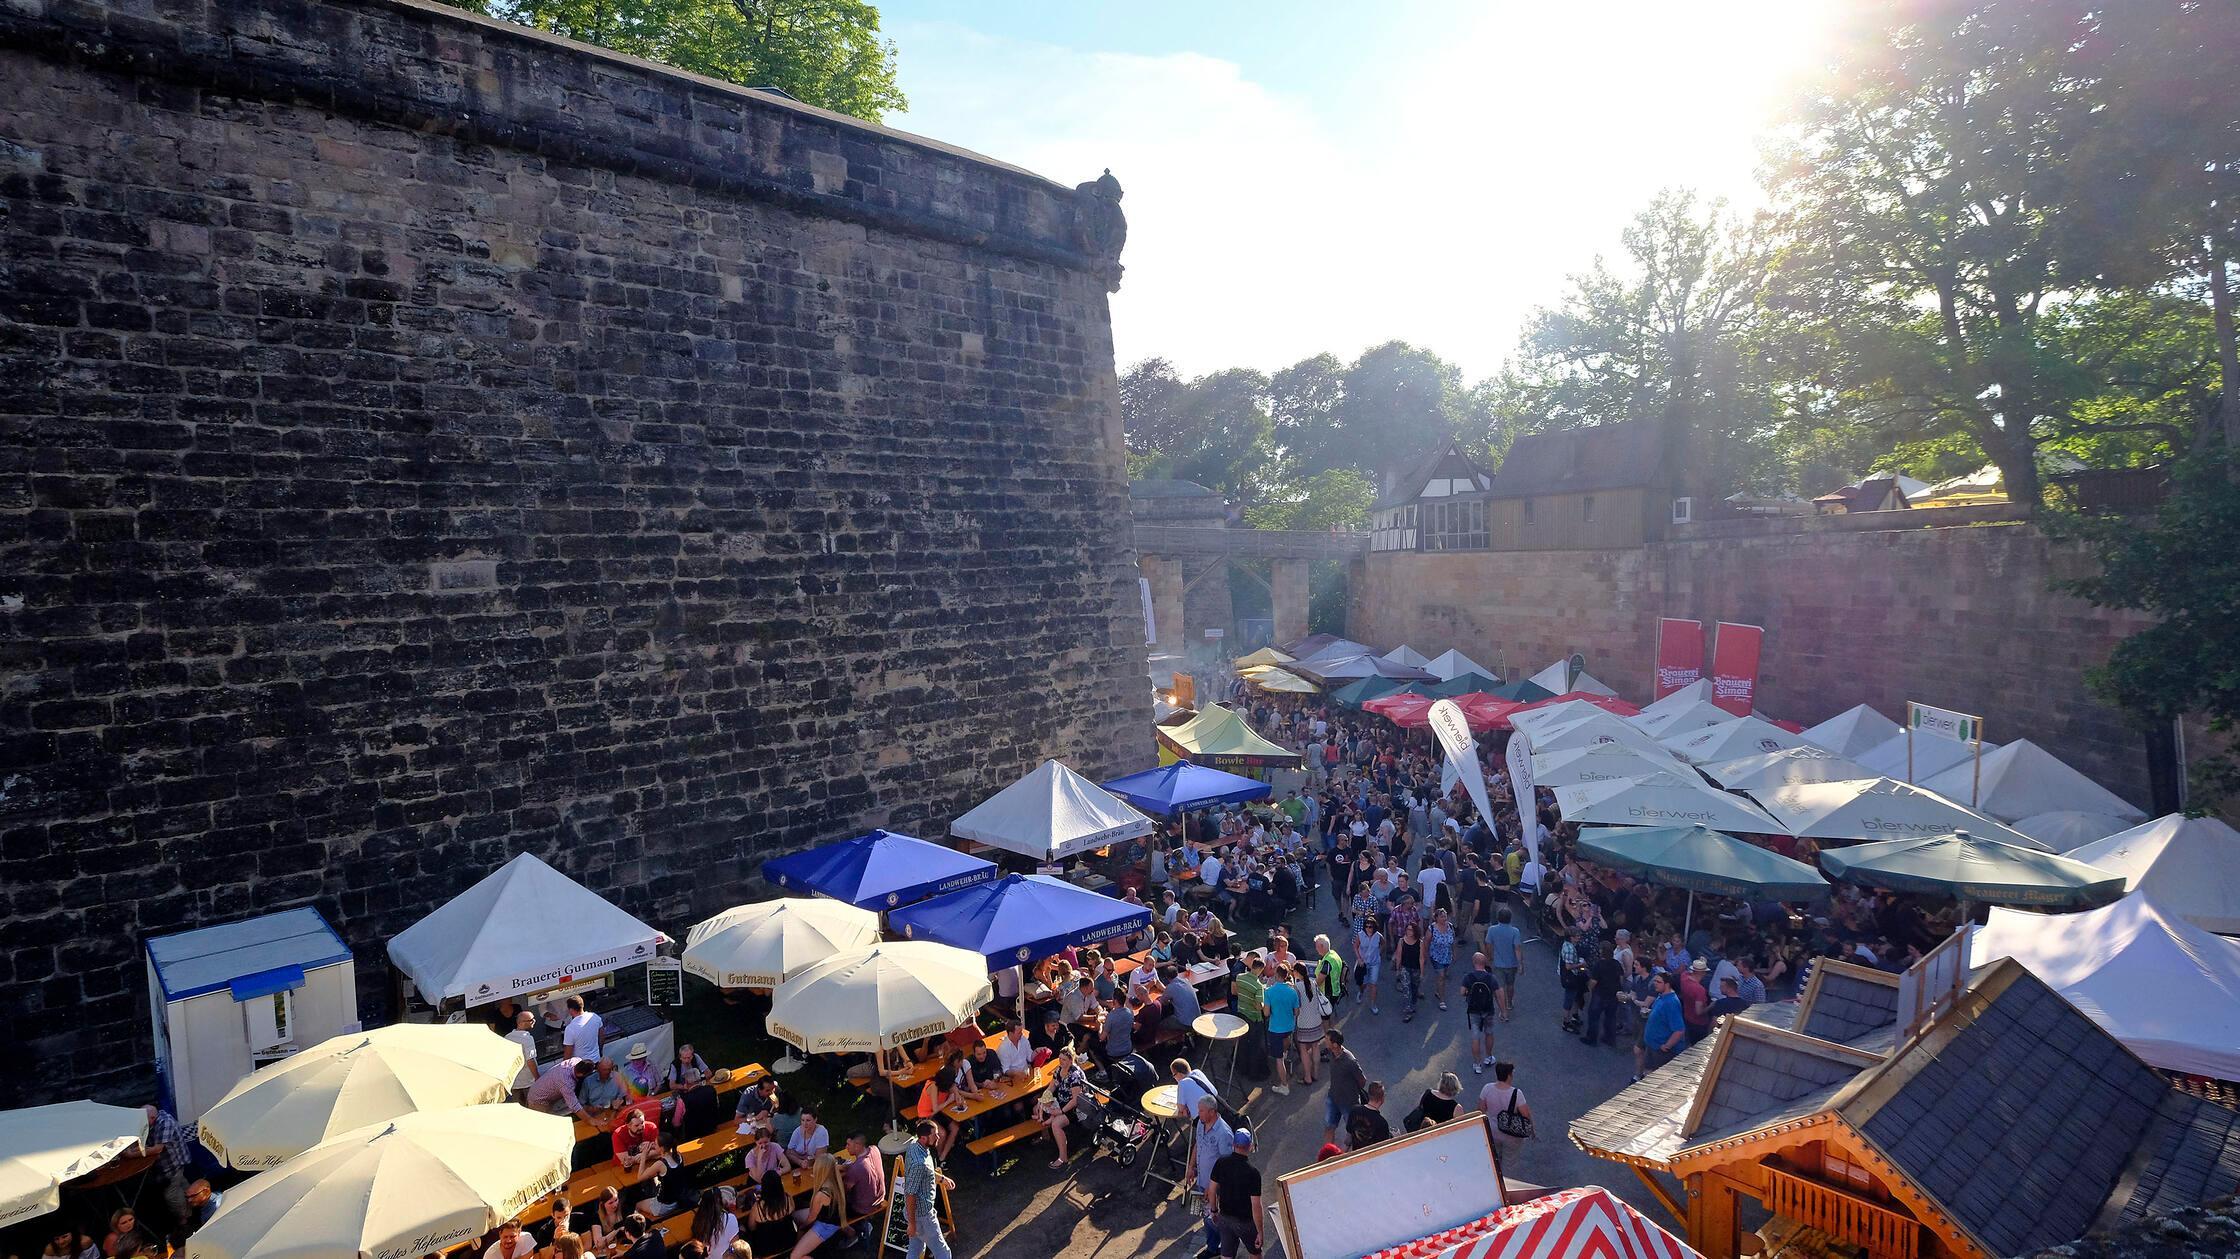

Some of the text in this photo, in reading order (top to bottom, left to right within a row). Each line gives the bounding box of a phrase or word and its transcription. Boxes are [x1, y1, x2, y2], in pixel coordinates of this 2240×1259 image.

[1659, 668, 1699, 678] Brauerei
[1662, 676, 1695, 685] Simon
[1713, 676, 1752, 687] Brauerei
[1716, 685, 1748, 695] Simon
[1215, 756, 1245, 765] Bowle
[1629, 806, 1718, 821] bierwerk
[1861, 817, 1960, 833] bierwerk
[1081, 919, 1143, 942] LANDWEHR-BRÄU
[512, 968, 561, 989] Brauerei
[564, 955, 618, 975] Gutmann
[728, 973, 776, 986] Gutmann
[772, 1022, 804, 1045] Gutmann
[891, 1020, 946, 1044] Gutmann
[837, 1037, 873, 1048] Hefeweizen
[0, 1203, 40, 1220] weizen
[411, 1226, 473, 1253] Hefeweizen
